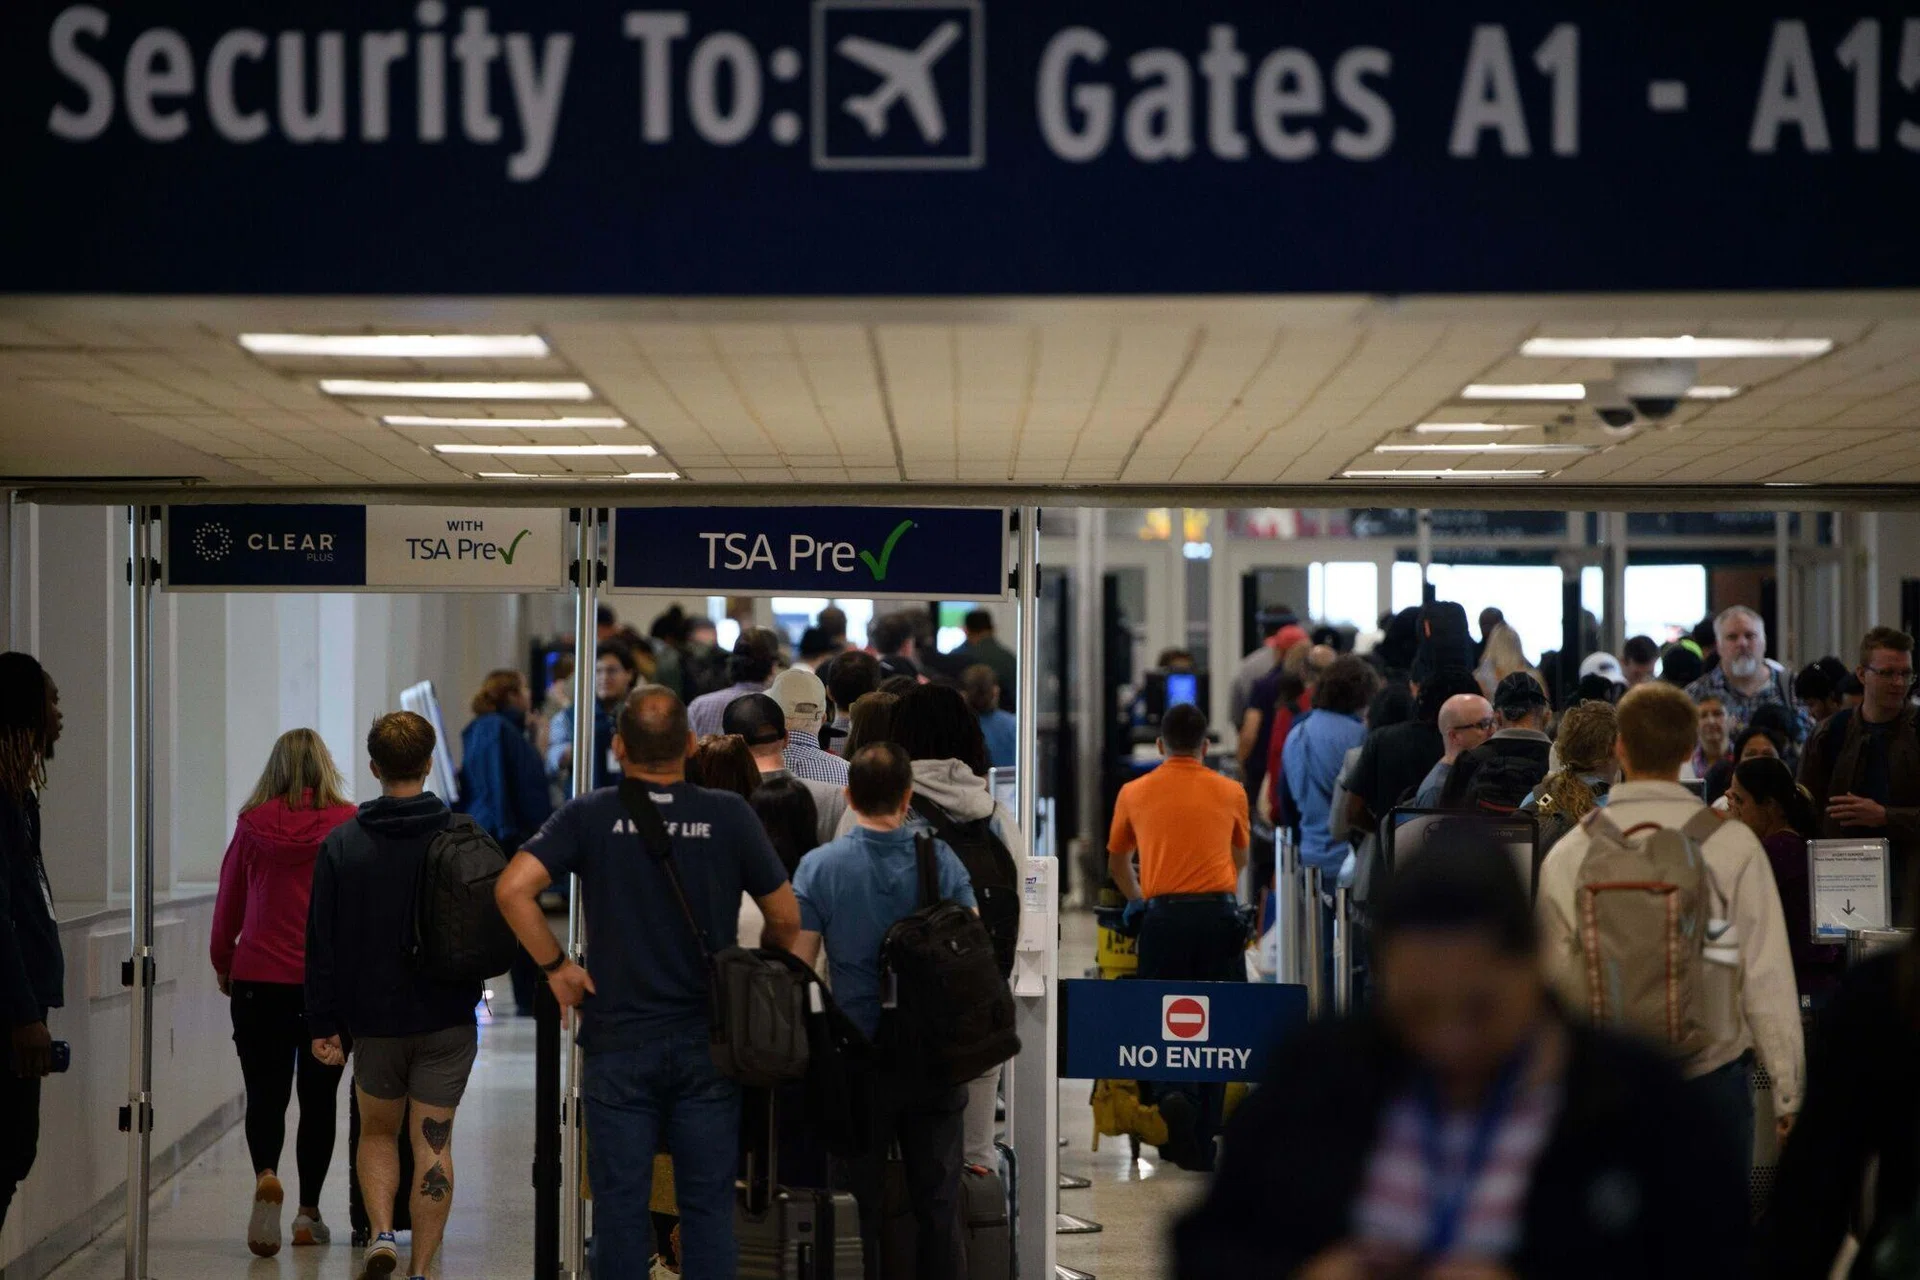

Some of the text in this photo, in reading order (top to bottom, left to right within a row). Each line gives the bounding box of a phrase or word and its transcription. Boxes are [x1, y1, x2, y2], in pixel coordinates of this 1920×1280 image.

[48, 0, 574, 182] Security
[622, 9, 802, 147] To:
[1035, 23, 1397, 164] Gates
[1446, 21, 1581, 159] A1
[1645, 78, 1689, 113] -
[446, 520, 484, 532] WITH
[247, 533, 334, 551] CLEAR
[405, 538, 498, 561] TSA Pre
[306, 553, 334, 562] PLUS
[699, 531, 857, 574] TSA Pre
[681, 821, 712, 839] LIFE
[1119, 1045, 1252, 1069] NO ENTRY
